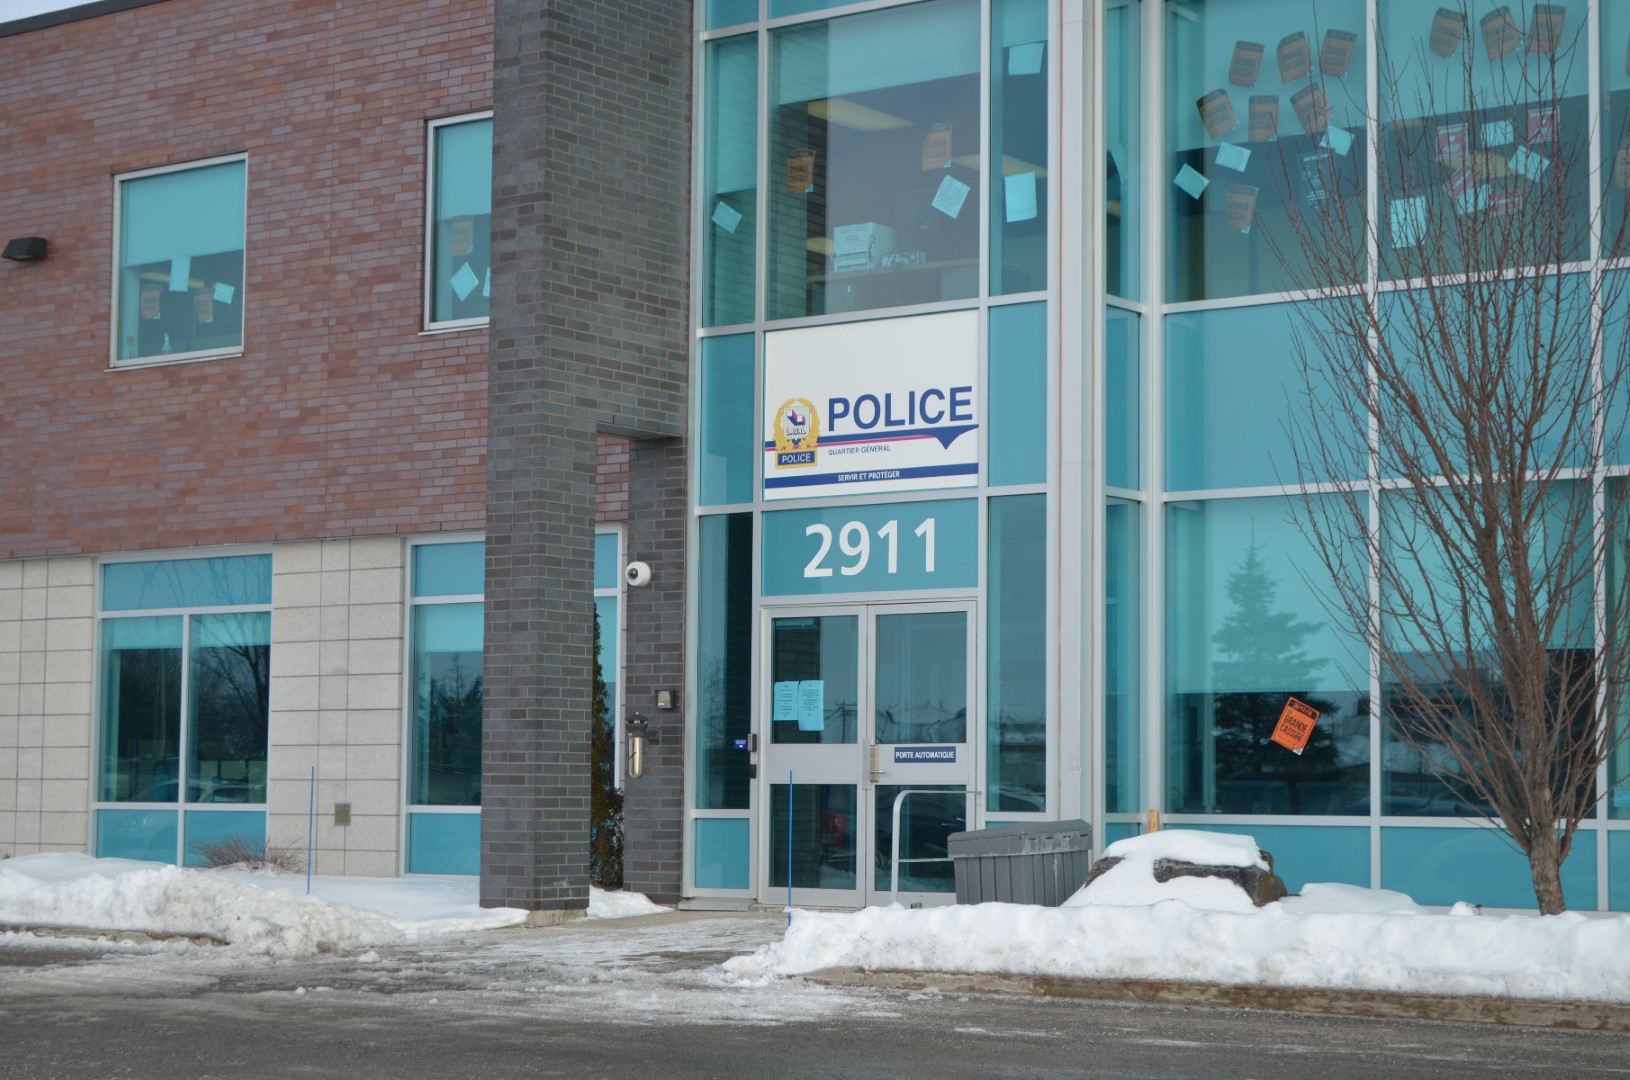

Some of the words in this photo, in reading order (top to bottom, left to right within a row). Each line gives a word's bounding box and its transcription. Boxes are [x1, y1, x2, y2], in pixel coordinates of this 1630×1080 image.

[828, 385, 973, 432] POLICE
[828, 446, 860, 456] QUARTIER
[861, 444, 891, 453] GÉNÉRAL
[781, 453, 811, 464] POLICE
[838, 473, 858, 482] SERVIR
[859, 472, 867, 480] ET
[868, 470, 900, 479] PROTÉGER
[803, 517, 936, 578] 2911
[1284, 714, 1308, 733] GRANDE
[895, 751, 914, 759] PORTE
[914, 751, 955, 759] AUTOMATIQUE
